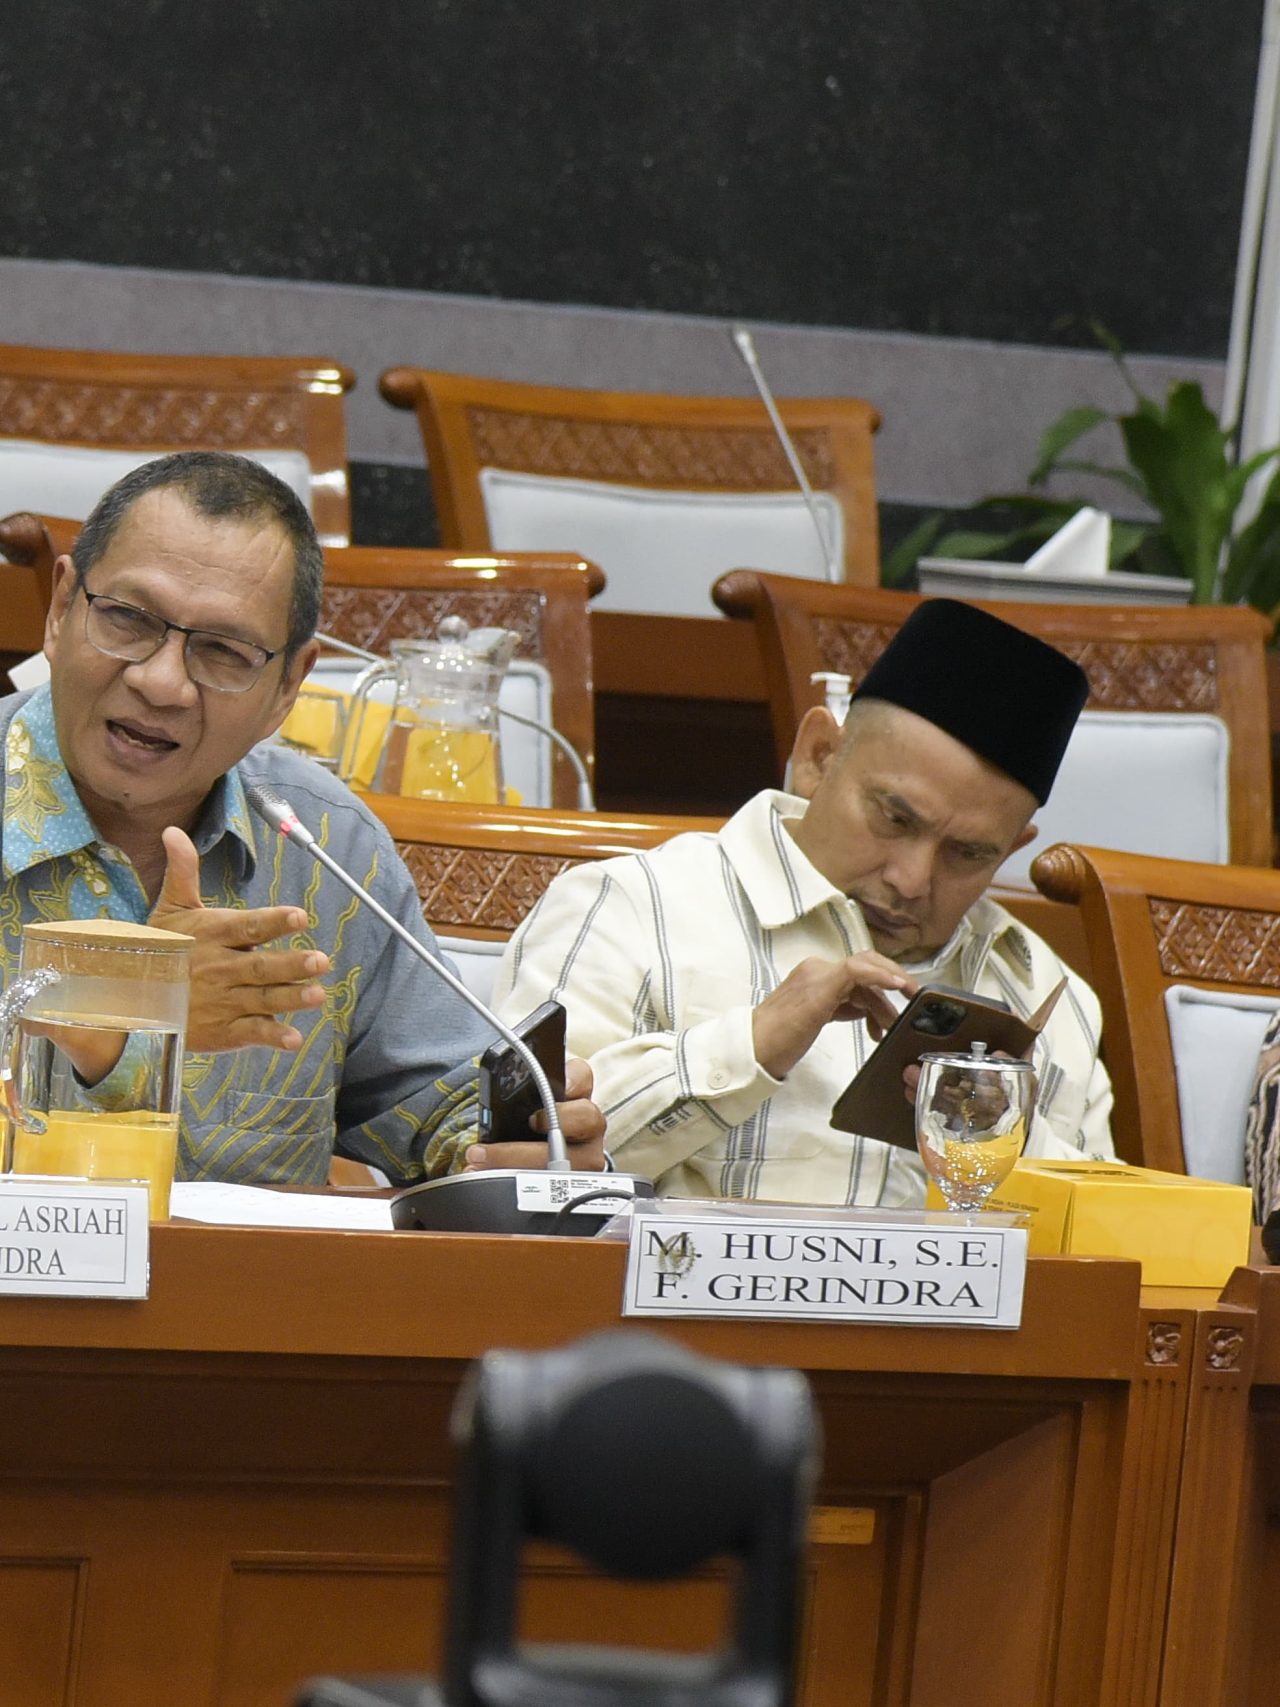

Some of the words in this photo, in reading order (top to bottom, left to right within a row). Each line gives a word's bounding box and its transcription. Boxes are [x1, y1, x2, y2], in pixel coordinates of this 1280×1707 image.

[14, 1205, 125, 1236] ASRIAH
[644, 1230, 703, 1259] M.
[720, 1232, 897, 1270] HUSNI,
[915, 1239, 999, 1268] S.E.
[653, 1271, 689, 1299] F.
[707, 1274, 984, 1308] GERINDRA
